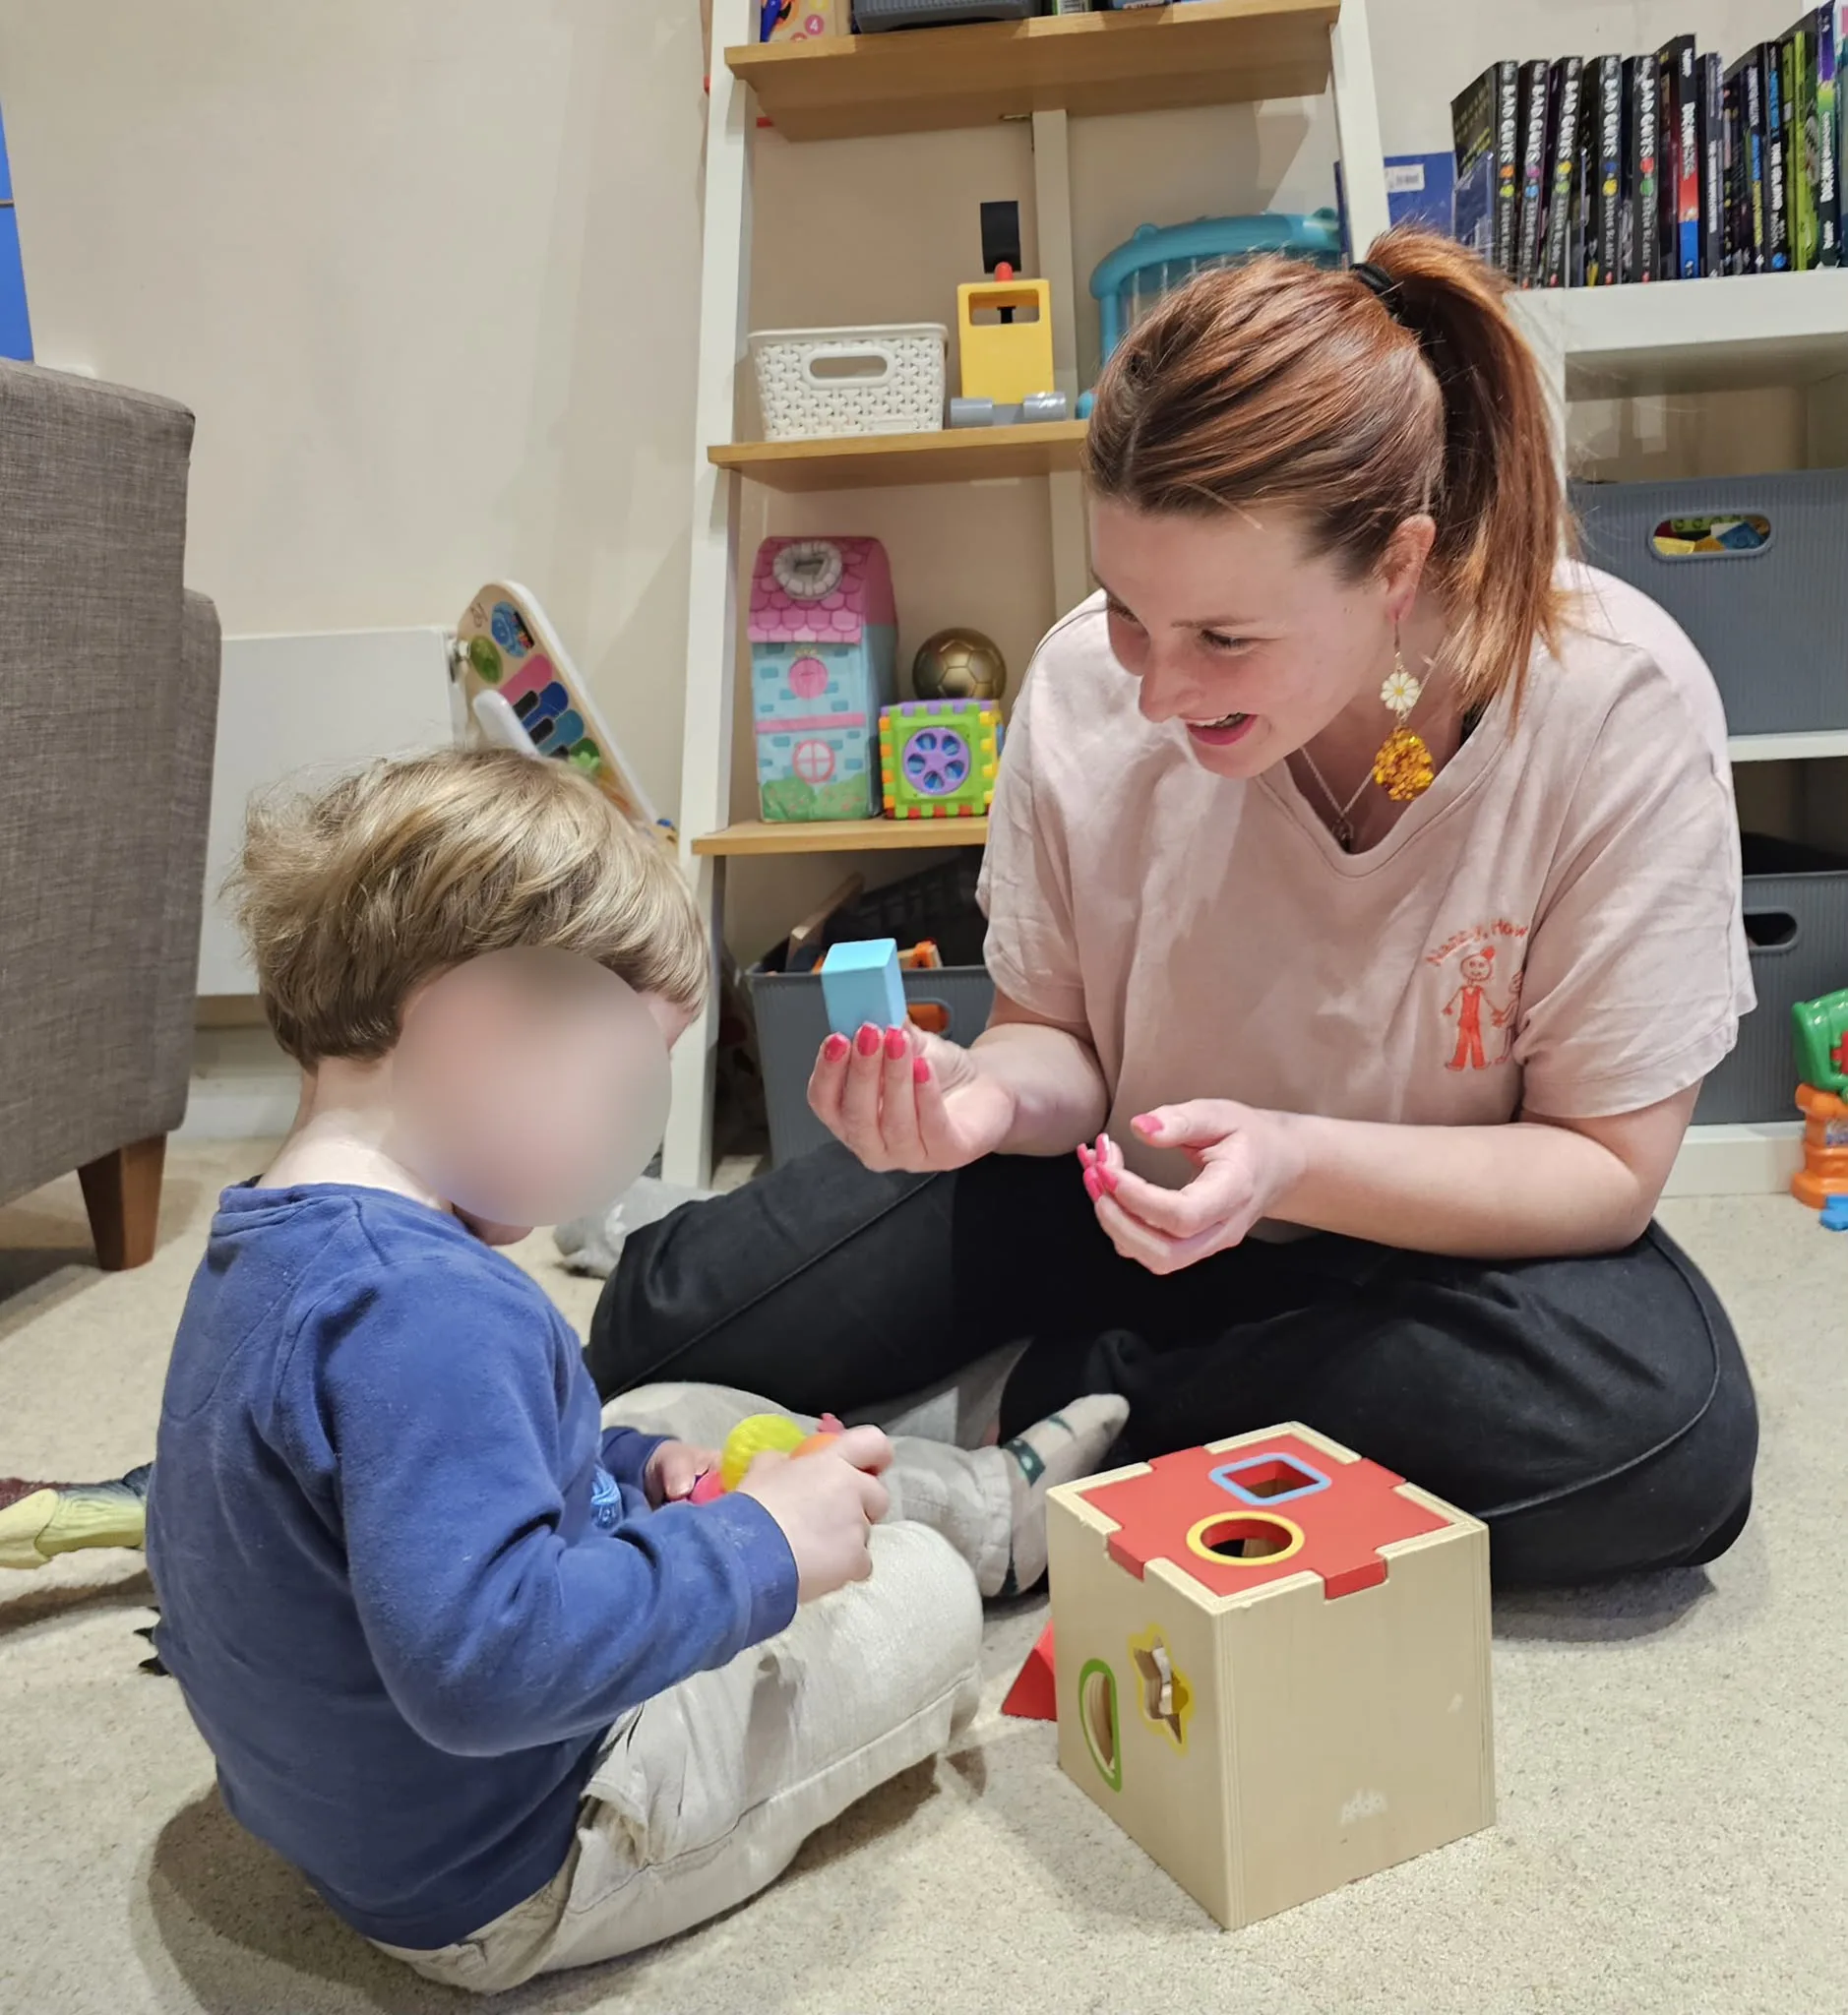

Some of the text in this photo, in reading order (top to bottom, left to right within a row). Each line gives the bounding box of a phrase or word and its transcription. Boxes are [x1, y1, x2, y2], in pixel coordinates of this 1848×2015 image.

[1502, 85, 1516, 118] BAD
[1531, 85, 1546, 118] BAD
[1563, 80, 1578, 114] BAD
[1604, 78, 1618, 112] BAD
[1640, 79, 1655, 113] BAD
[1500, 119, 1515, 163] GUYS
[1525, 118, 1544, 163] GUYS
[1558, 114, 1575, 159] GUYS
[1602, 112, 1619, 157] GUYS
[1639, 113, 1655, 157] GUYS
